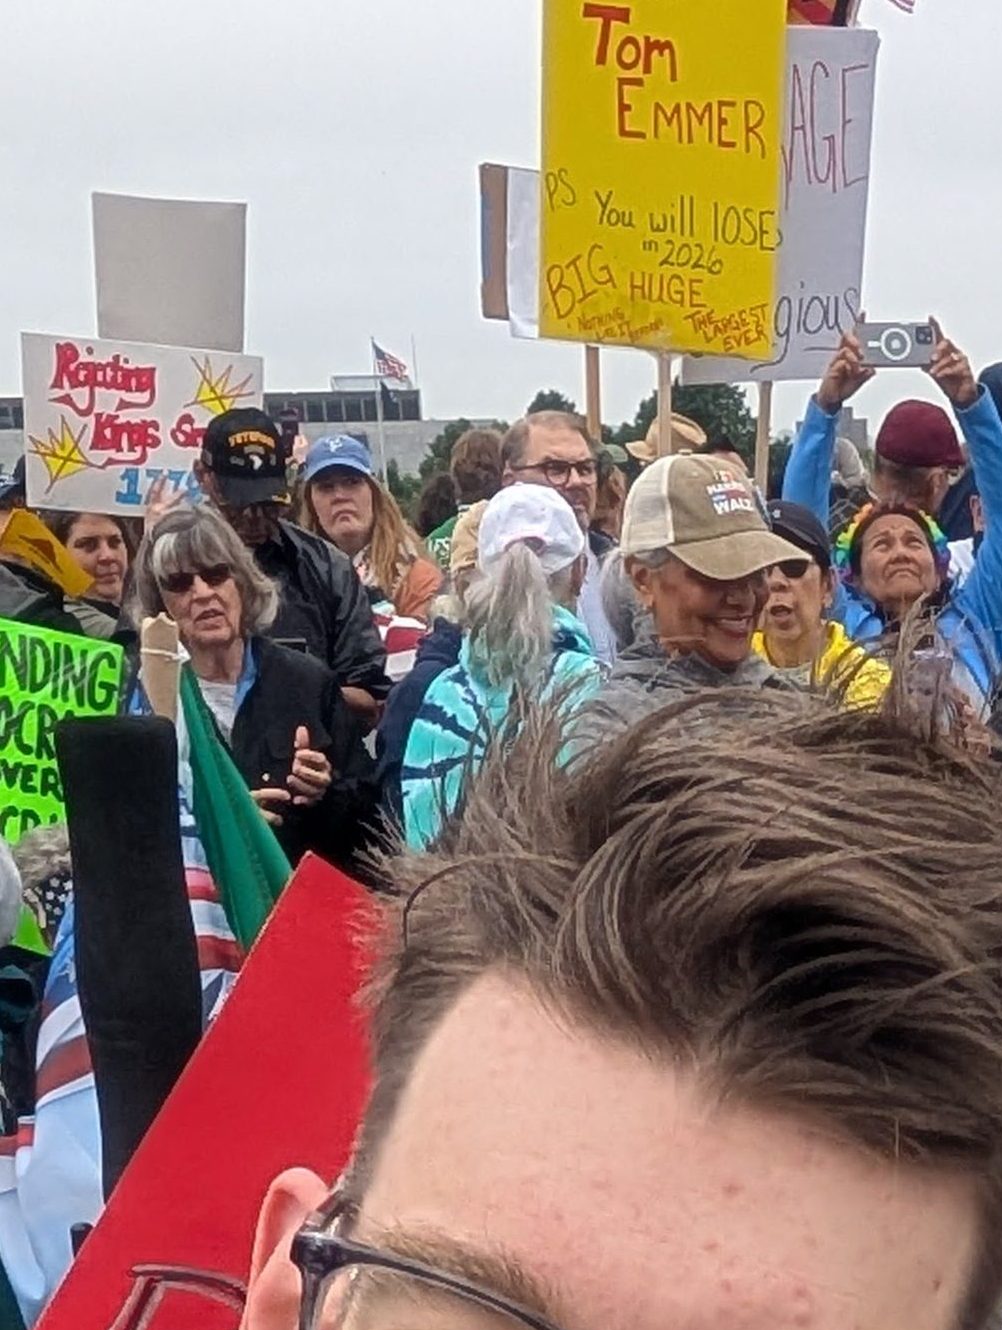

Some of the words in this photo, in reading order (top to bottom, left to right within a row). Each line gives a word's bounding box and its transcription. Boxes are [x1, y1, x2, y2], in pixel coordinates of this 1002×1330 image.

[582, 2, 678, 82] Tom
[617, 77, 766, 159] EMMER
[594, 189, 636, 229] You
[649, 194, 695, 237] will
[659, 239, 724, 275] 2026
[546, 244, 617, 320] BIG
[629, 271, 708, 309] HUGE
[683, 308, 722, 334] THE
[702, 303, 769, 344] LARGEST
[723, 323, 769, 353] EVER
[89, 412, 162, 469] Kings
